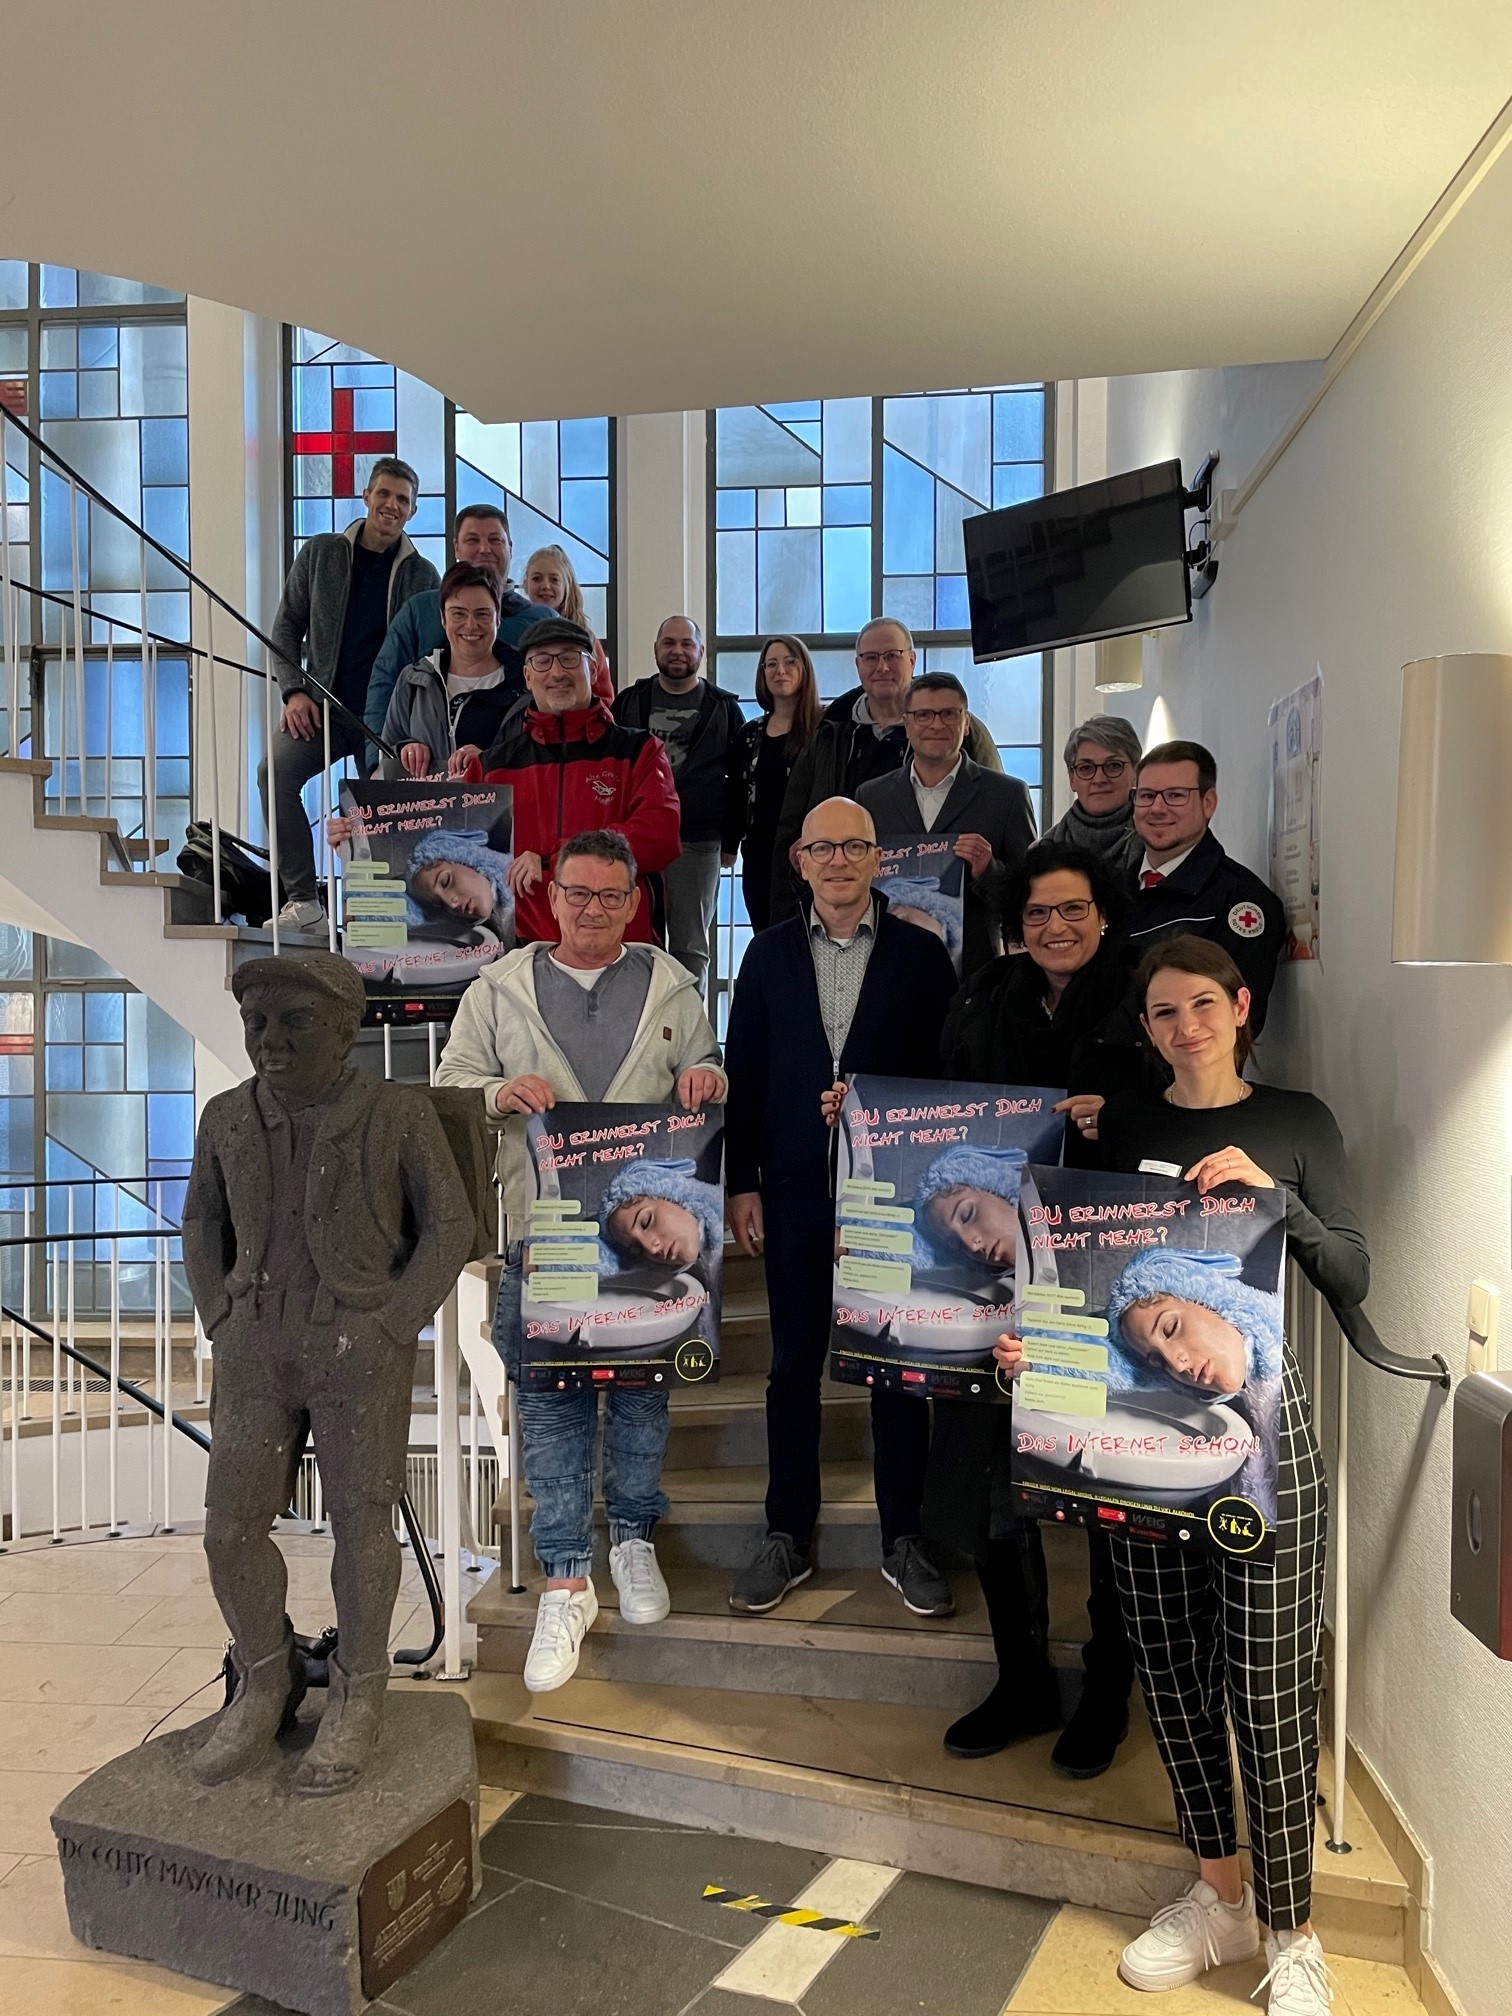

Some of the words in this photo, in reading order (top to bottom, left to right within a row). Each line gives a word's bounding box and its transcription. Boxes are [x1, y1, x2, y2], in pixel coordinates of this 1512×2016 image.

[349, 805, 372, 820] DU
[377, 796, 457, 816] ERINNERST
[462, 791, 496, 808] DICH
[351, 821, 393, 836] NICHT
[398, 815, 443, 831] MEHR?
[916, 841, 949, 857] DICH
[383, 951, 448, 971] INTERNET
[455, 941, 505, 960] SCHON!
[850, 1108, 880, 1127] DU
[886, 1102, 988, 1123] ERINNERST
[995, 1098, 1042, 1117] DICH
[536, 1133, 564, 1152] DU
[569, 1120, 661, 1146] ERINNERST
[667, 1113, 706, 1133] DICH
[852, 1130, 904, 1148] NICHT
[910, 1125, 969, 1143] MEHR?
[538, 1151, 586, 1170] NICHT
[592, 1142, 645, 1162] MEHR?
[1029, 1205, 1062, 1225] DU
[1069, 1200, 1191, 1222] ERINNERST
[1200, 1196, 1255, 1217] DICH
[1031, 1231, 1091, 1249] NICHT
[1099, 1226, 1168, 1245] MEHR?
[527, 1320, 560, 1339] DAS
[567, 1305, 645, 1332] INTERNET
[653, 1291, 711, 1314] SCHON!
[836, 1307, 870, 1325] DAS
[877, 1305, 963, 1325] INTERNET
[1017, 1432, 1058, 1452] DAS
[1066, 1433, 1169, 1453] INTERNET
[1178, 1434, 1261, 1453] SCHON!
[1131, 1513, 1165, 1528] WEIG
[268, 1888, 336, 1932] JUNG
